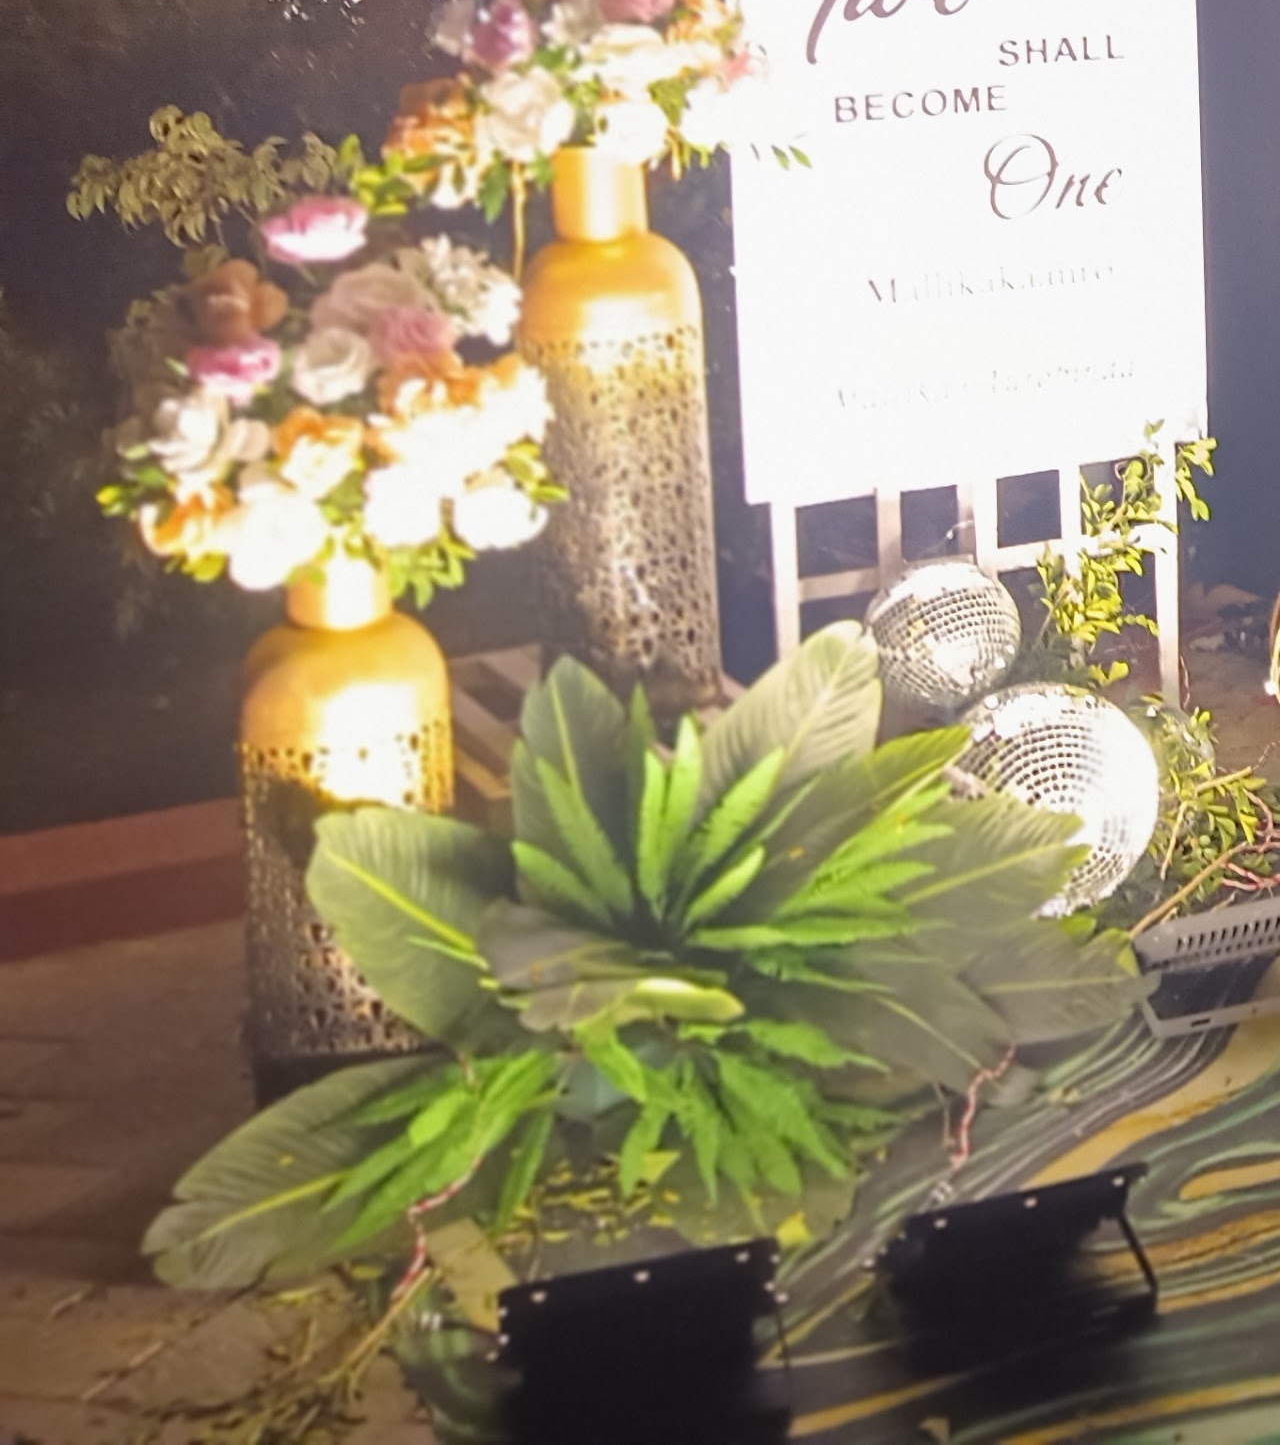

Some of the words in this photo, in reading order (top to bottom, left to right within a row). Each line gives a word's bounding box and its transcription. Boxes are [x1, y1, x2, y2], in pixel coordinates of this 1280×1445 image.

[998, 34, 1124, 67] SHALL
[834, 85, 1007, 123] BECOME
[983, 134, 1122, 220] One
